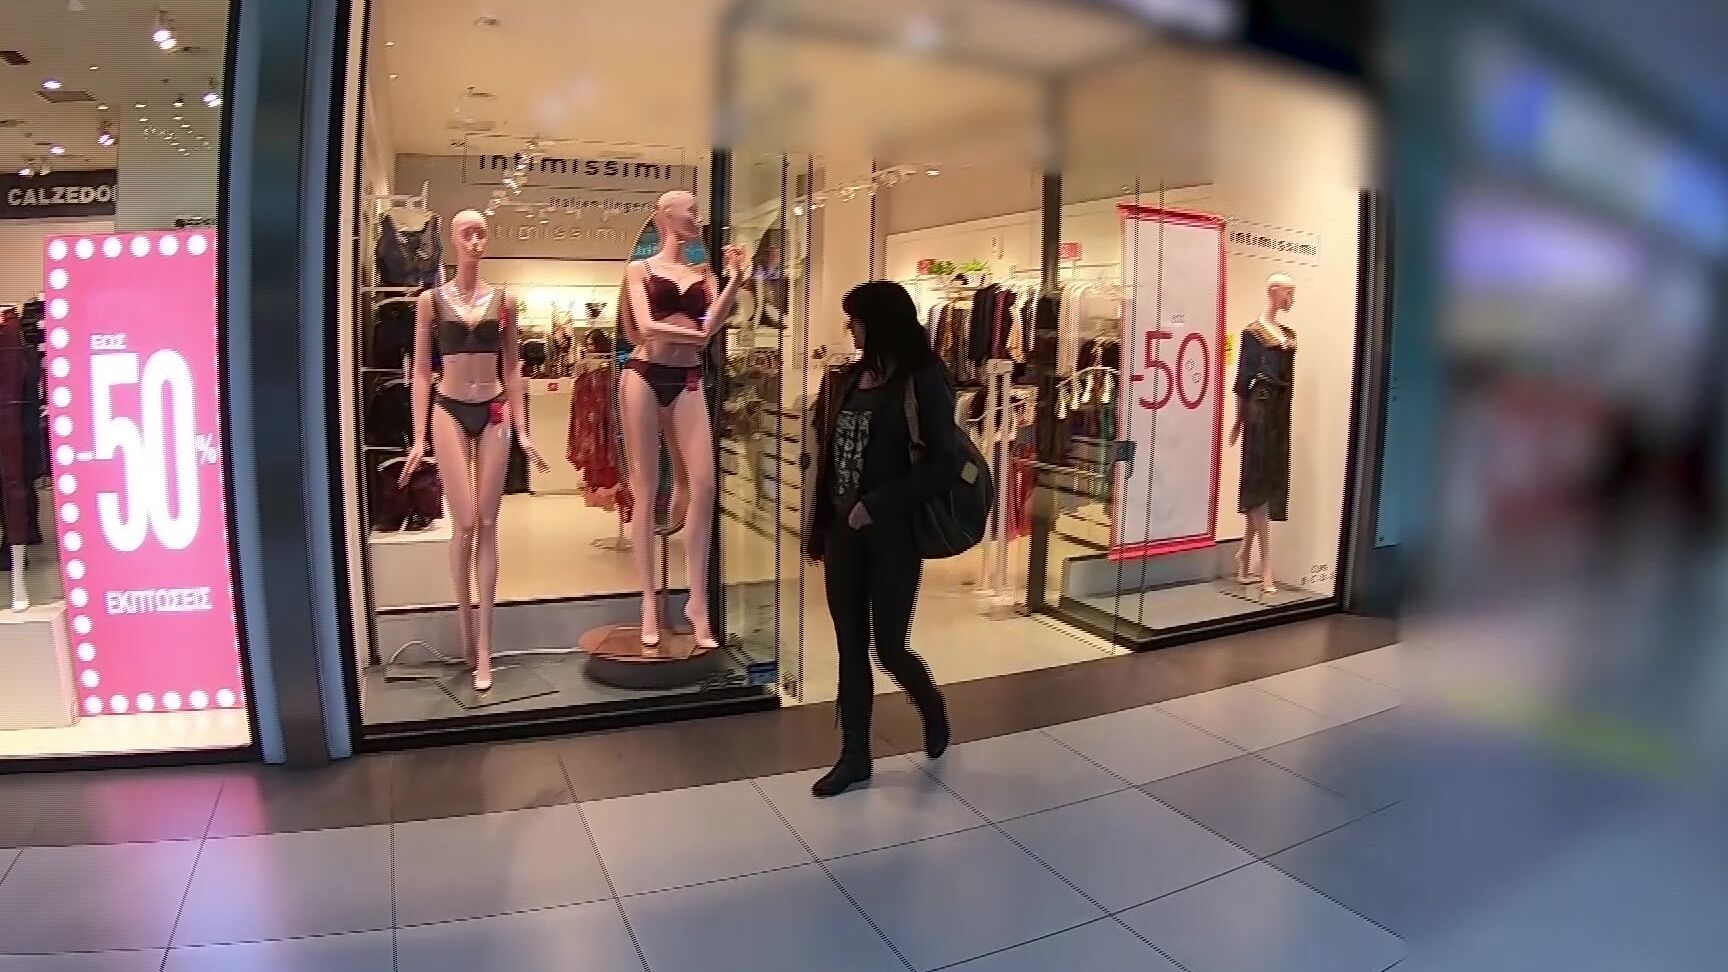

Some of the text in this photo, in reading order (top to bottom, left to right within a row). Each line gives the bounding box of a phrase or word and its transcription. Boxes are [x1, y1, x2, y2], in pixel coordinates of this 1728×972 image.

[479, 153, 673, 180] intimissimi
[1229, 231, 1317, 256] intimissimi
[104, 586, 214, 615] ΕΚΠΤΩΣΕΙΣ
